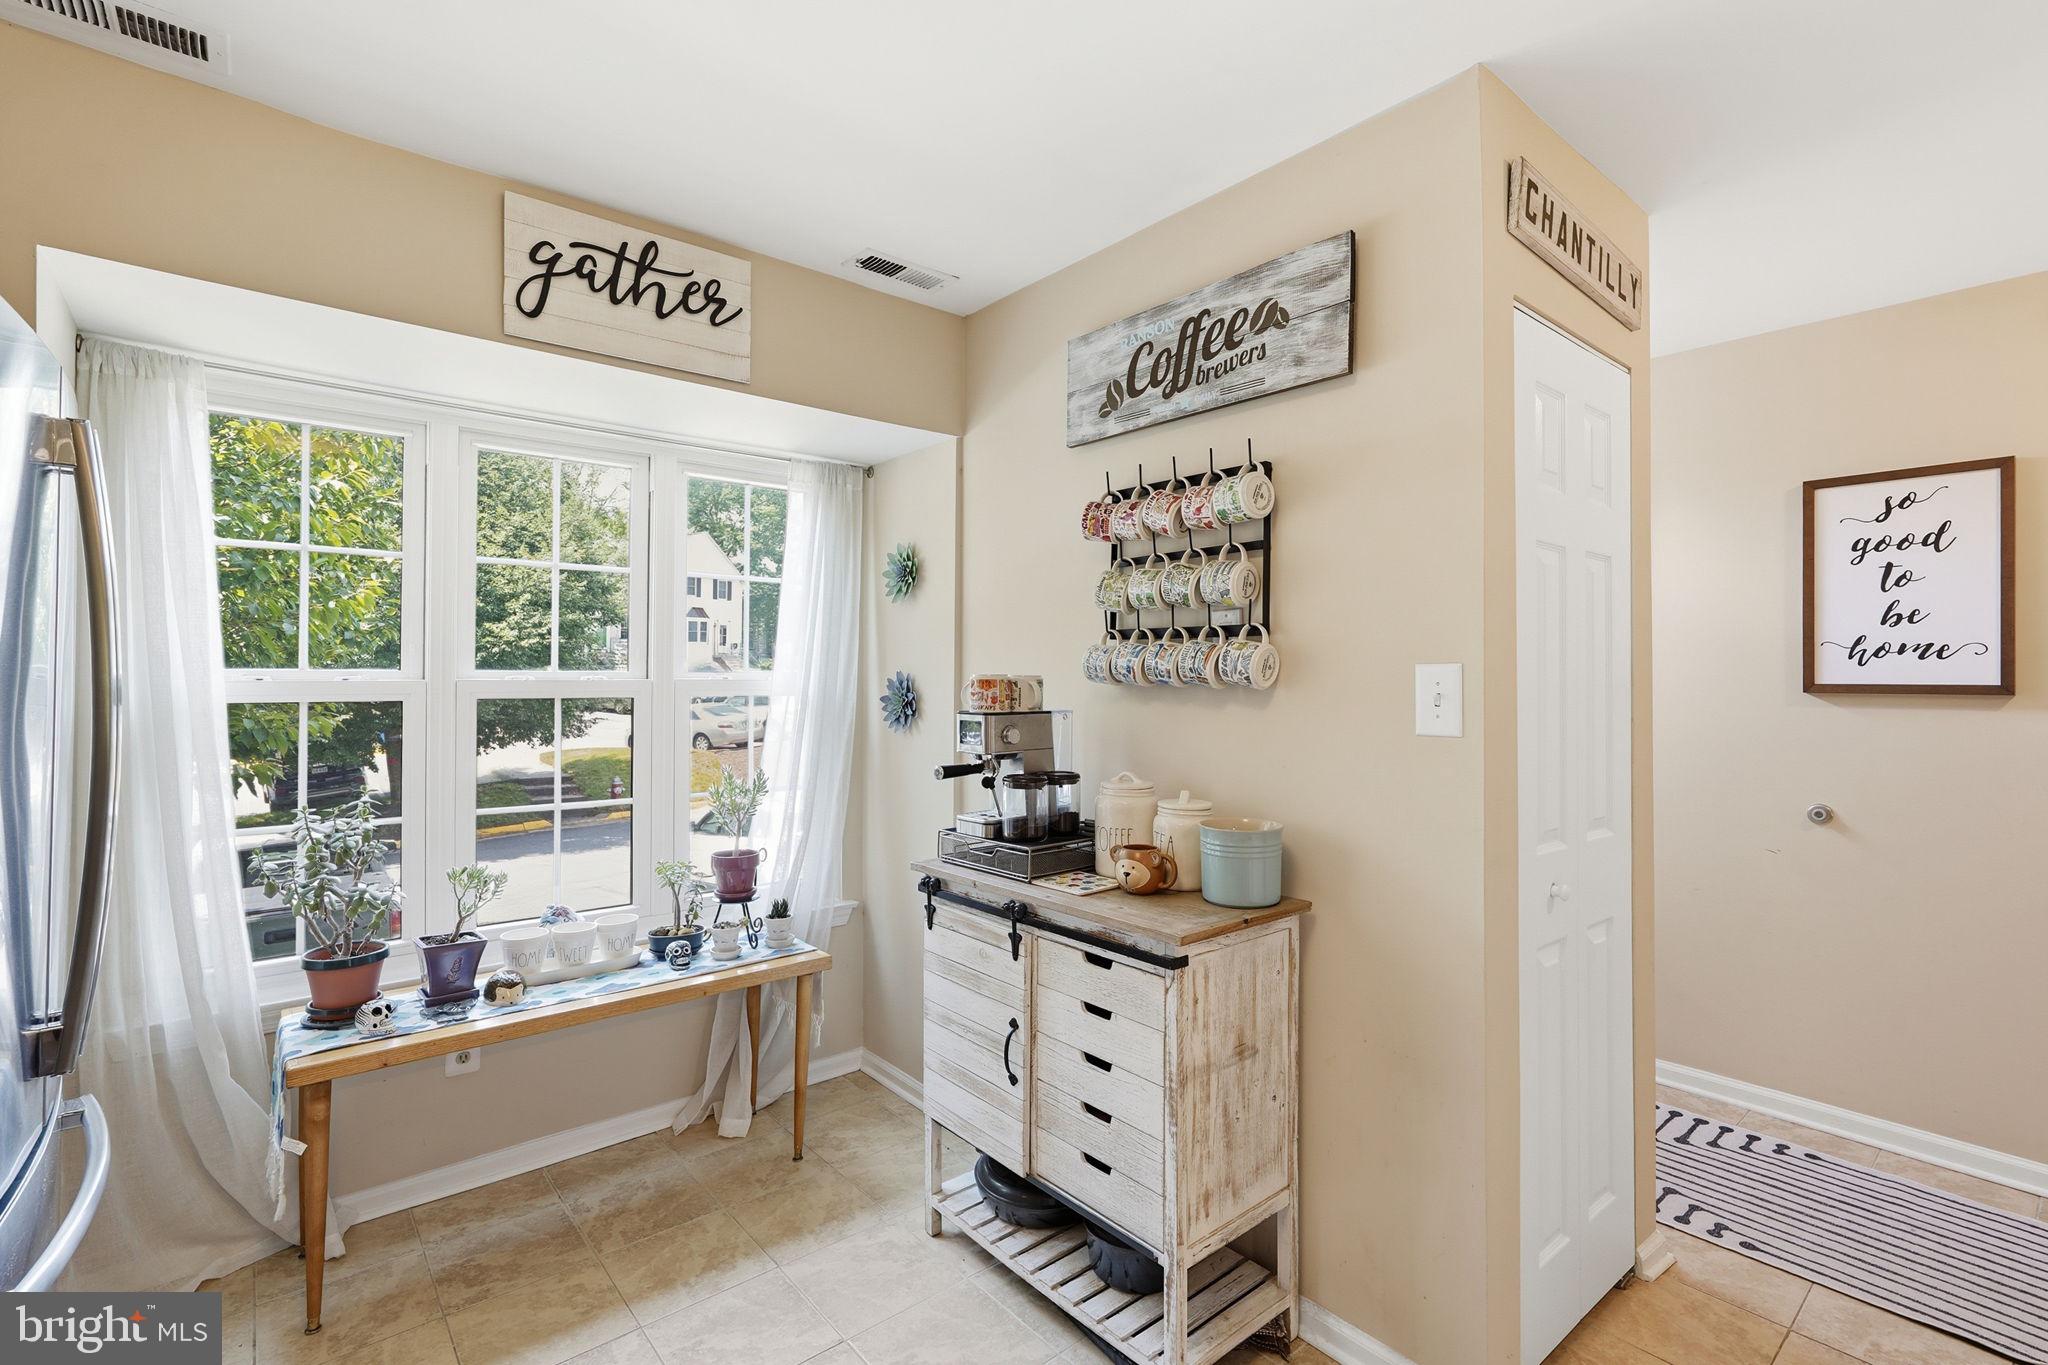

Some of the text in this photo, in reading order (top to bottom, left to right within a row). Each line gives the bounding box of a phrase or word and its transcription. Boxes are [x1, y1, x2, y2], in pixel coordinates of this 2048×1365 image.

[1525, 177, 1639, 309] CHANTILLY
[515, 240, 743, 327] gather
[1126, 308, 1250, 400] Coffee
[1195, 342, 1267, 386] brewers
[1839, 485, 1949, 524] so
[1850, 520, 1957, 566] good
[1878, 561, 1927, 593] to
[1880, 599, 1931, 628] be
[1820, 634, 1989, 667] home
[1096, 825, 1134, 852] COFFEE
[1154, 830, 1176, 861] TEA
[511, 948, 543, 969] HOME
[558, 945, 590, 964] SWEET
[606, 933, 636, 952] HOME
